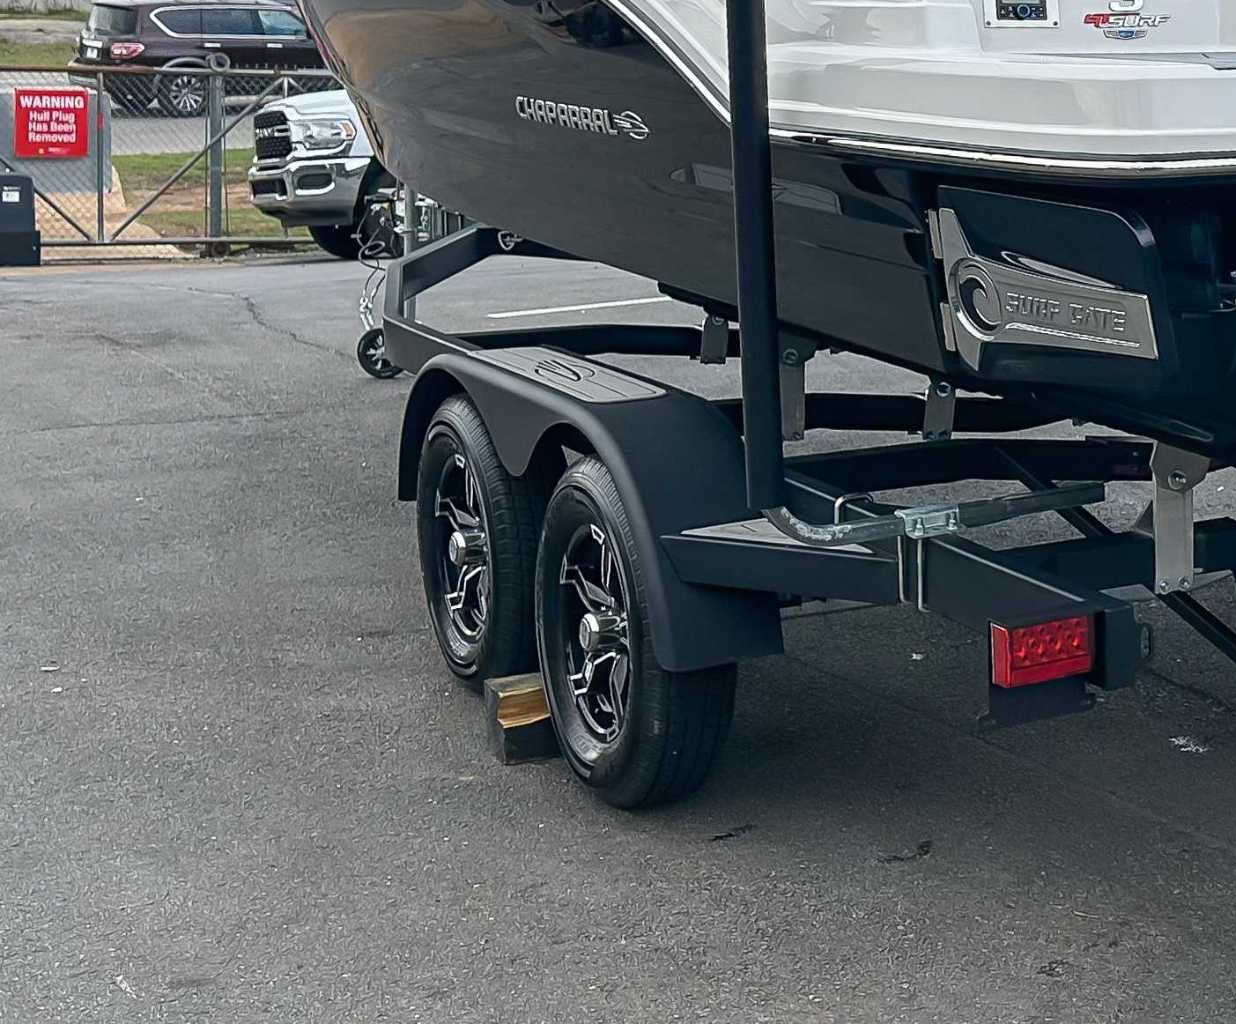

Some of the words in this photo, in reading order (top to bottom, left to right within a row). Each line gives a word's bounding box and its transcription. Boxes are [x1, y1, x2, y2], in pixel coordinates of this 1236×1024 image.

[20, 95, 85, 108] WARNING
[29, 110, 51, 121] Hull
[52, 110, 76, 124] Plug
[515, 96, 618, 136] CHAPARRAL
[28, 121, 49, 132] Has
[50, 121, 77, 132] Been
[28, 132, 77, 143] Removed
[1005, 292, 1061, 322] SURF
[1069, 302, 1128, 332] GATE
